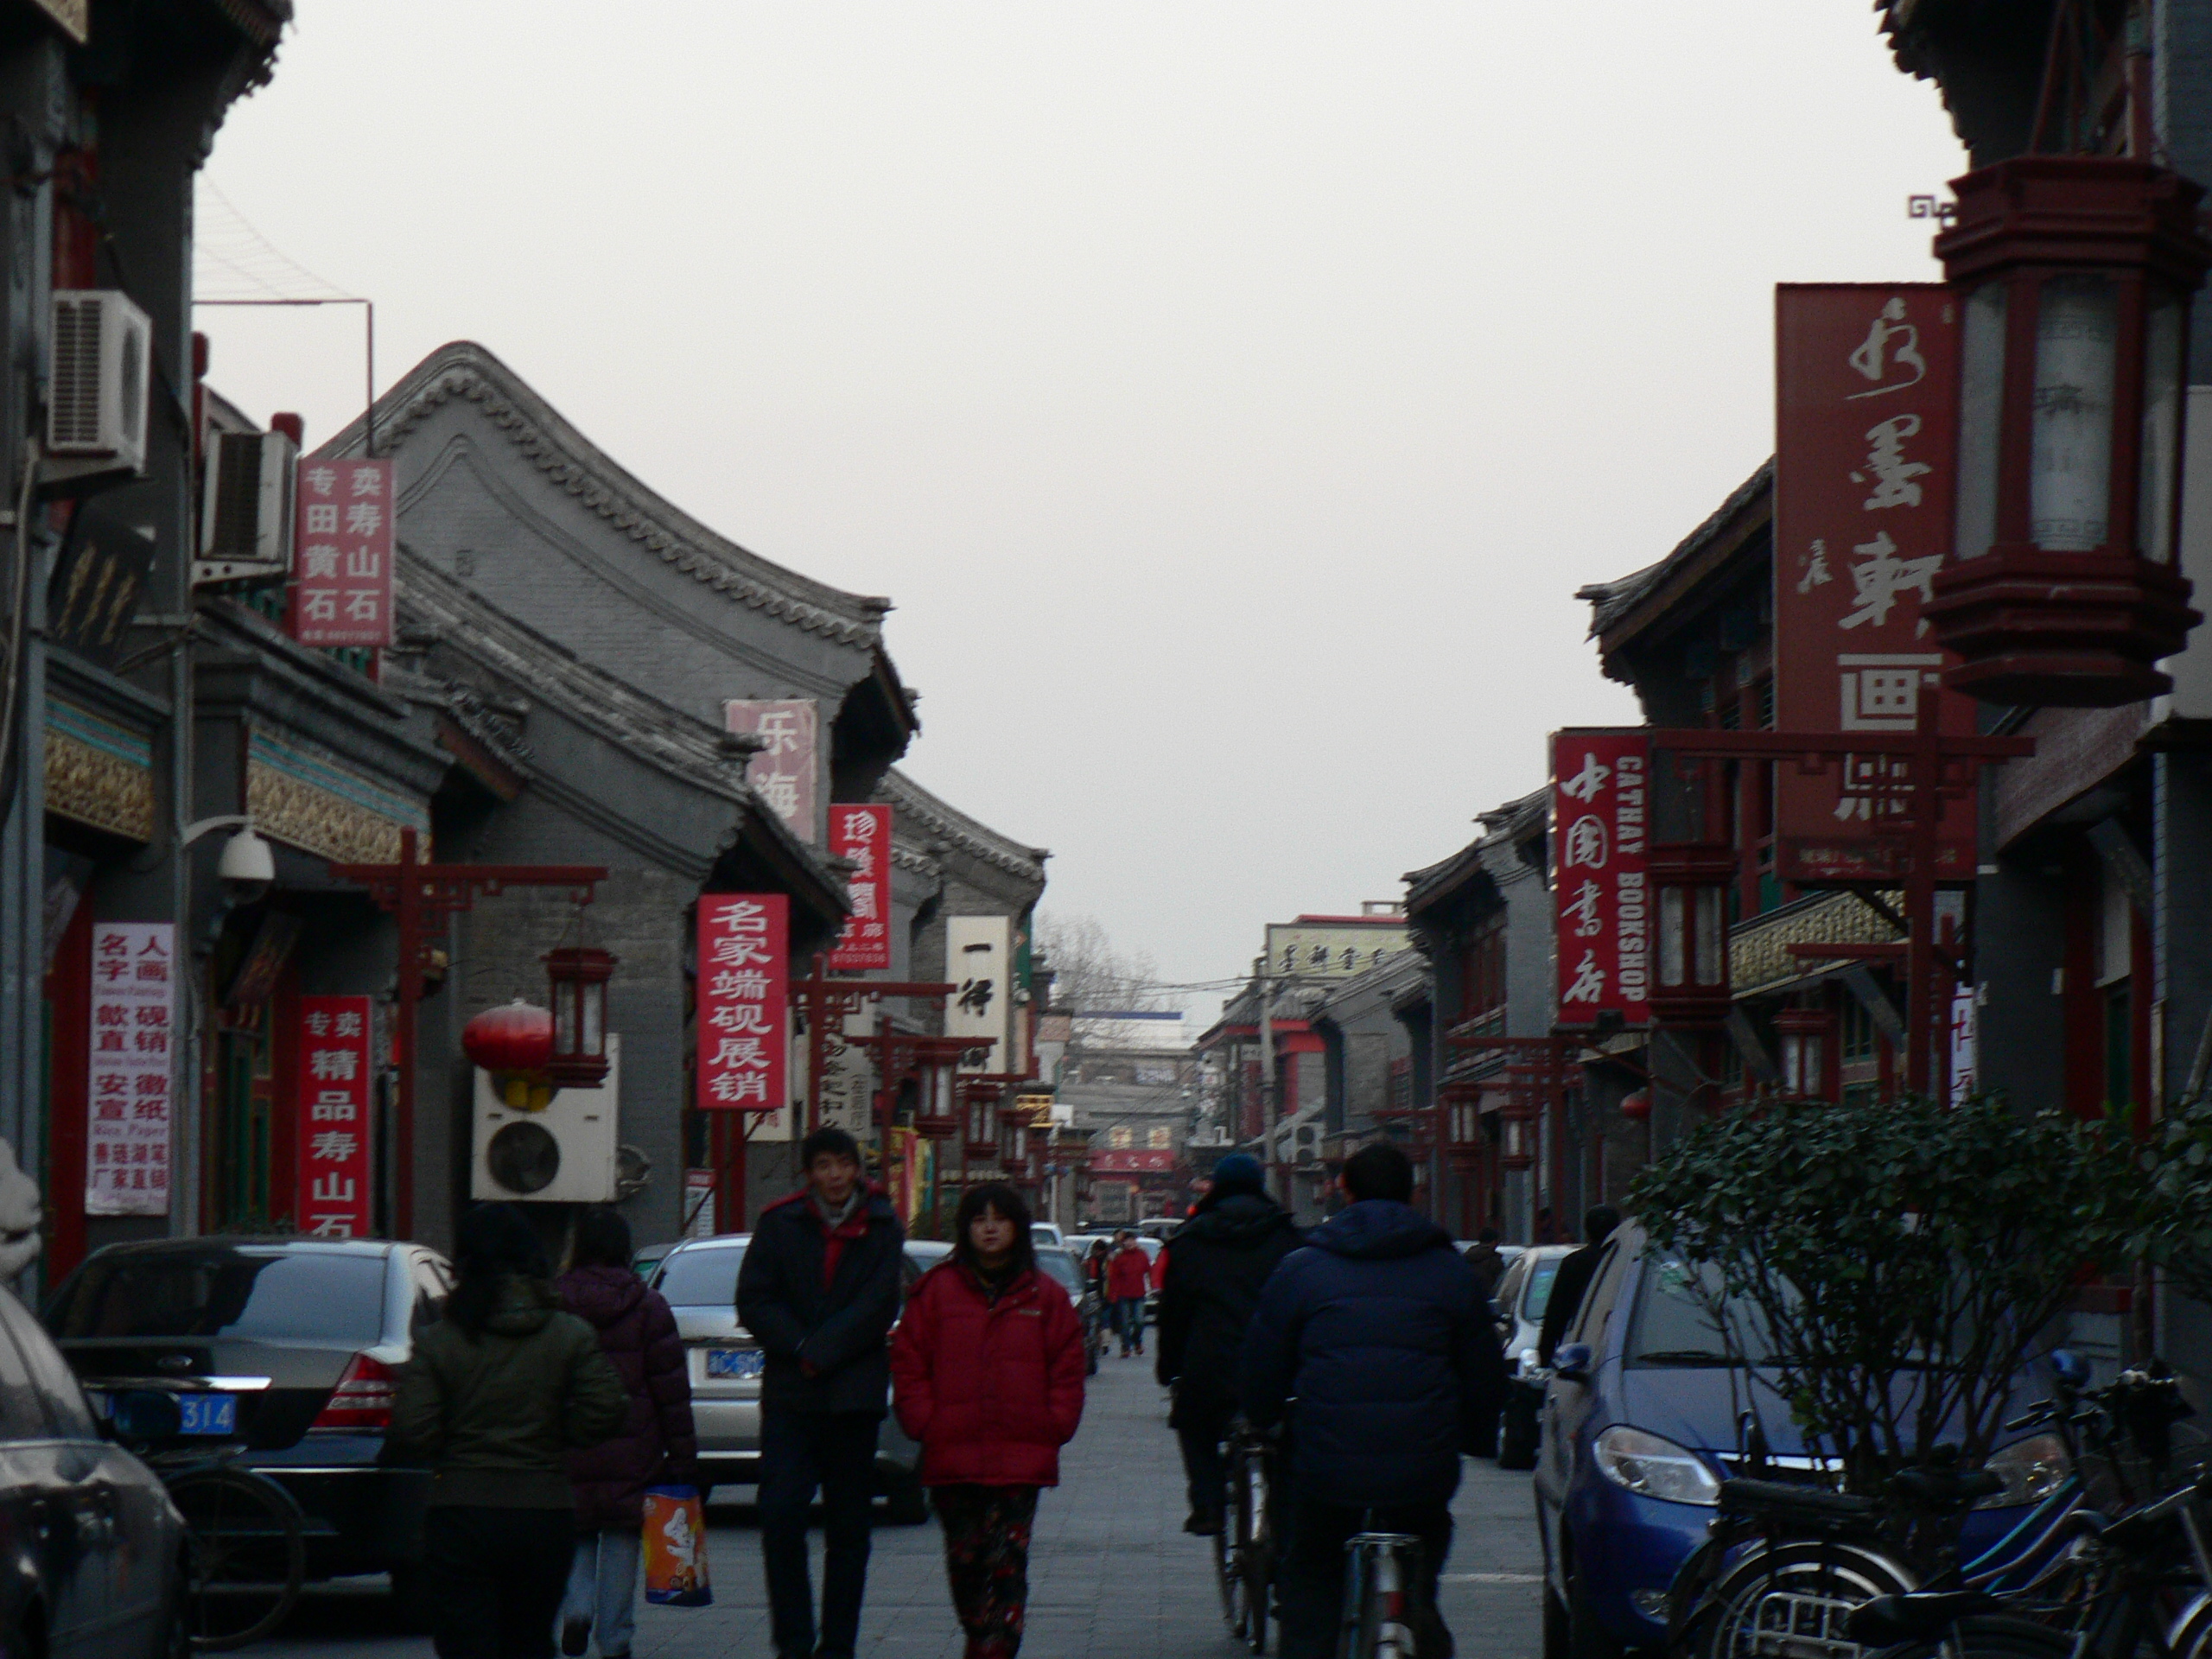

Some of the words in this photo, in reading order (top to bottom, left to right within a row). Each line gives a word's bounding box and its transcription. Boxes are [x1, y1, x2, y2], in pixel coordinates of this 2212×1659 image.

[304, 467, 382, 497] 专卖
[1615, 755, 1646, 854] CATHAY
[100, 934, 167, 956] 名人
[1617, 871, 1647, 1002] BOOKSHOP
[98, 960, 168, 982] 字画
[708, 900, 774, 1103] 名家端砚展销
[305, 1011, 362, 1037] 专卖
[97, 1031, 167, 1052] 直销
[98, 1074, 167, 1095] 安徽
[94, 1099, 167, 1121] 宣纸
[309, 1048, 359, 1238] 精品寿山石
